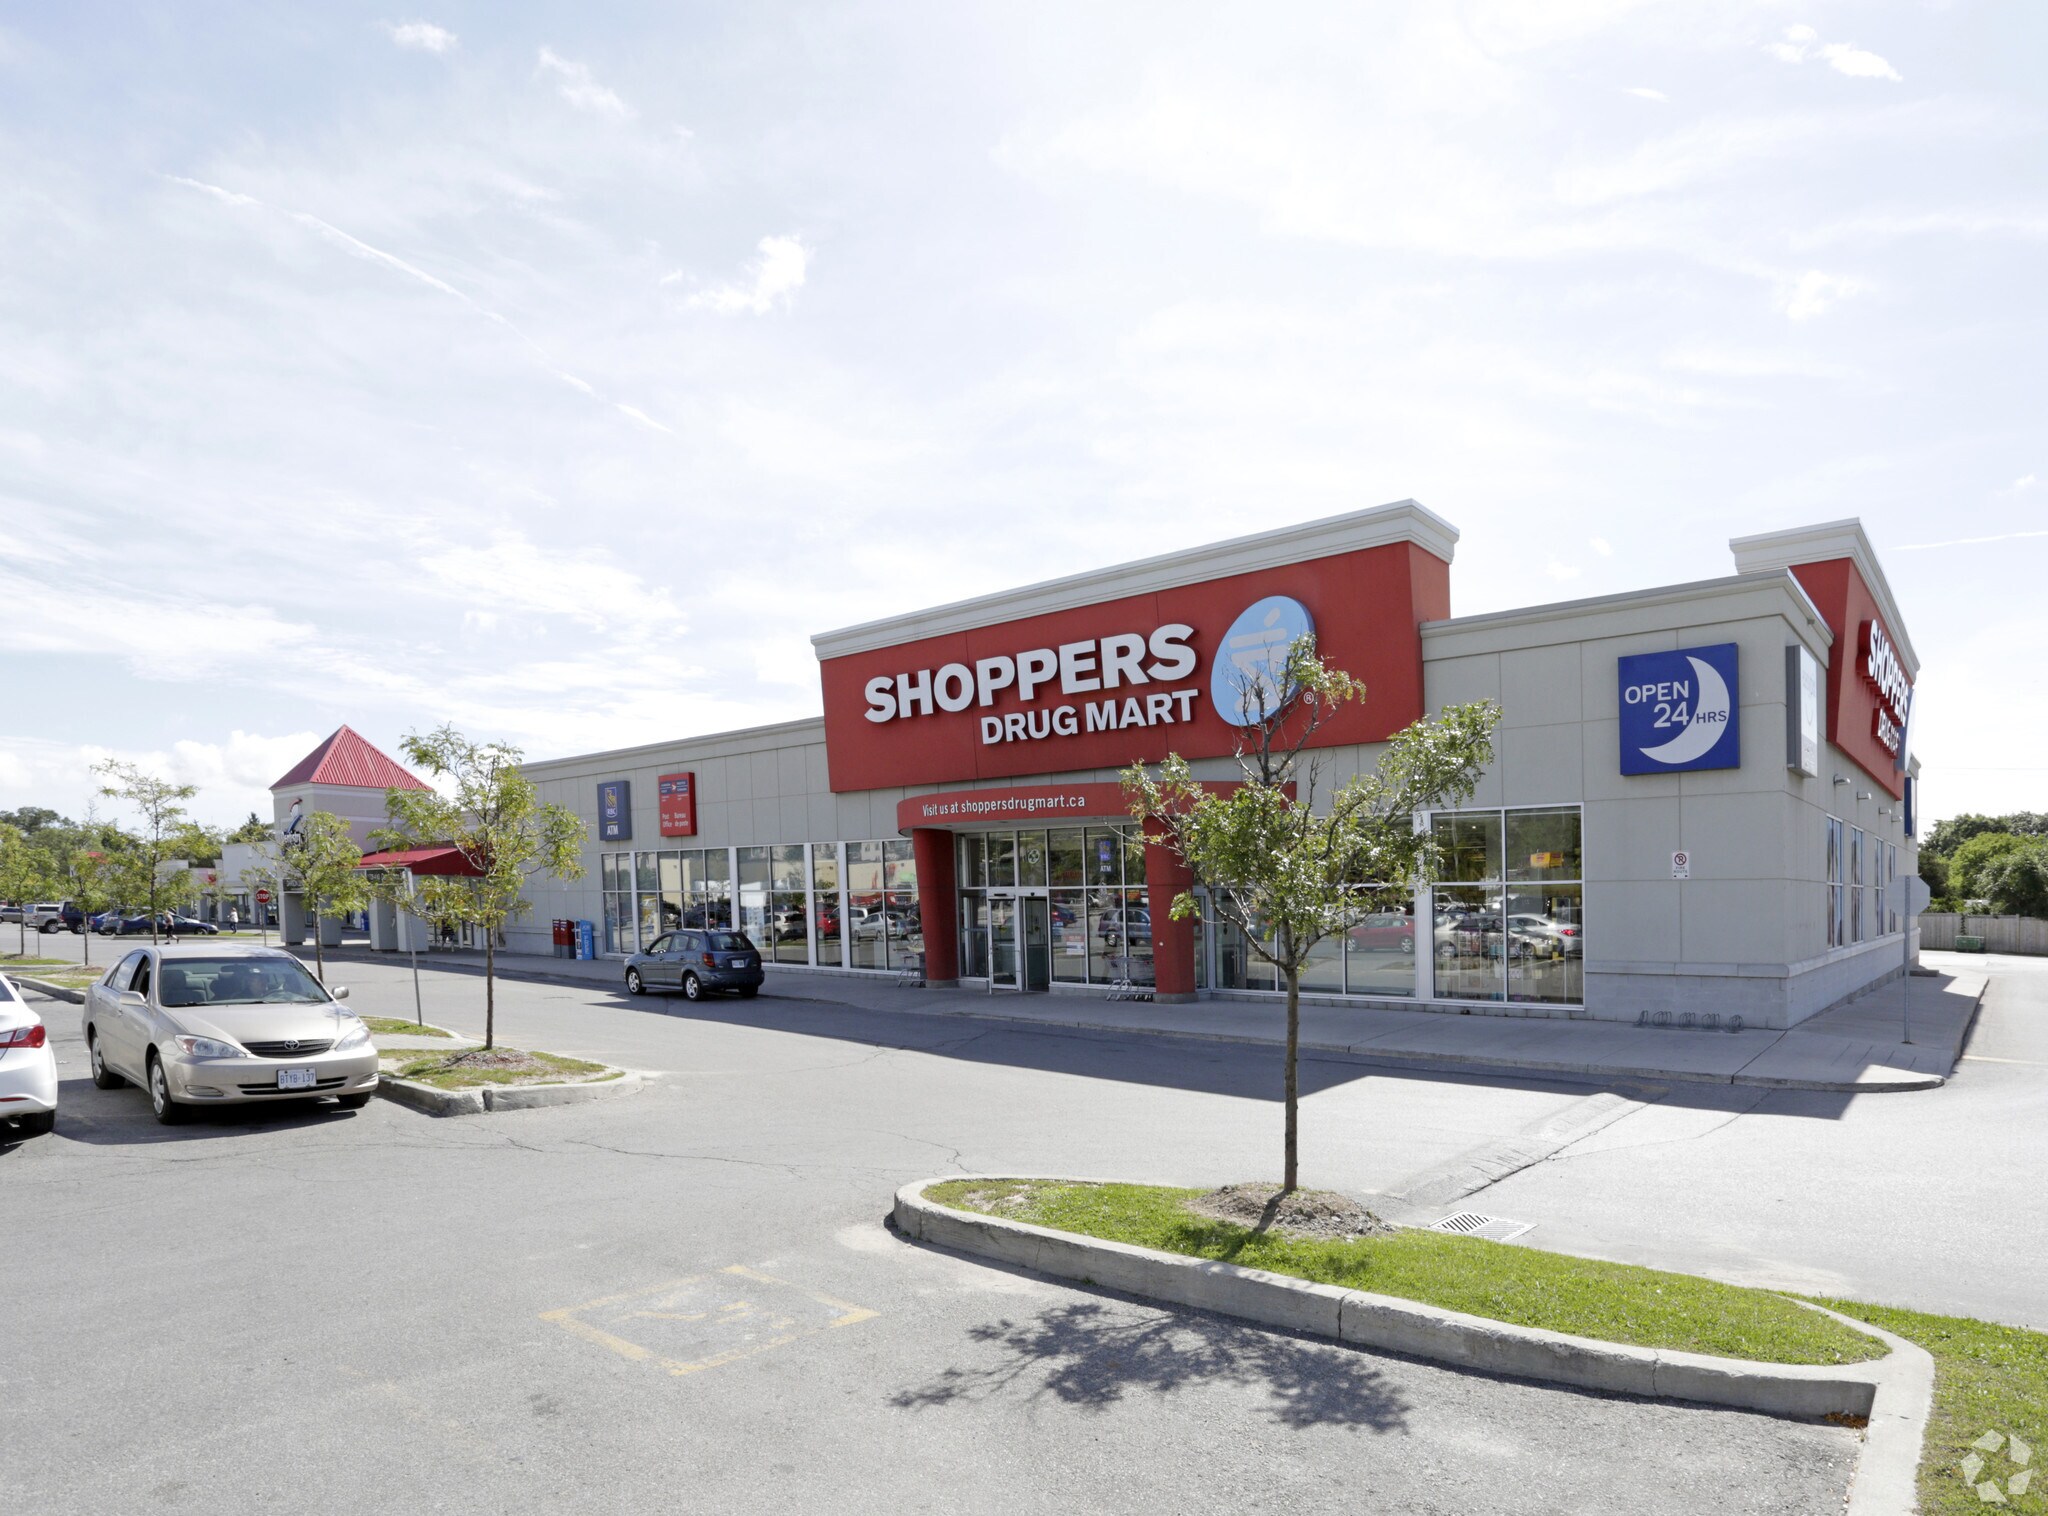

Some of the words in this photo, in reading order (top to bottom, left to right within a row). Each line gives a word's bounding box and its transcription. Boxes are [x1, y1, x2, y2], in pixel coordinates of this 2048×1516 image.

[864, 623, 1197, 723] SHOPPERS
[1868, 619, 1908, 727] SHOPPERS
[1624, 680, 1689, 704] OPEN
[981, 705, 1079, 745] DRUG
[1085, 689, 1198, 732] MART
[1653, 702, 1689, 728] 24
[1696, 710, 1727, 724] HRS
[922, 804, 938, 817] Visit
[940, 805, 949, 814] us
[951, 802, 959, 814] at
[961, 794, 1085, 814] shoppersdrugmart.ca
[607, 825, 618, 836] ATM
